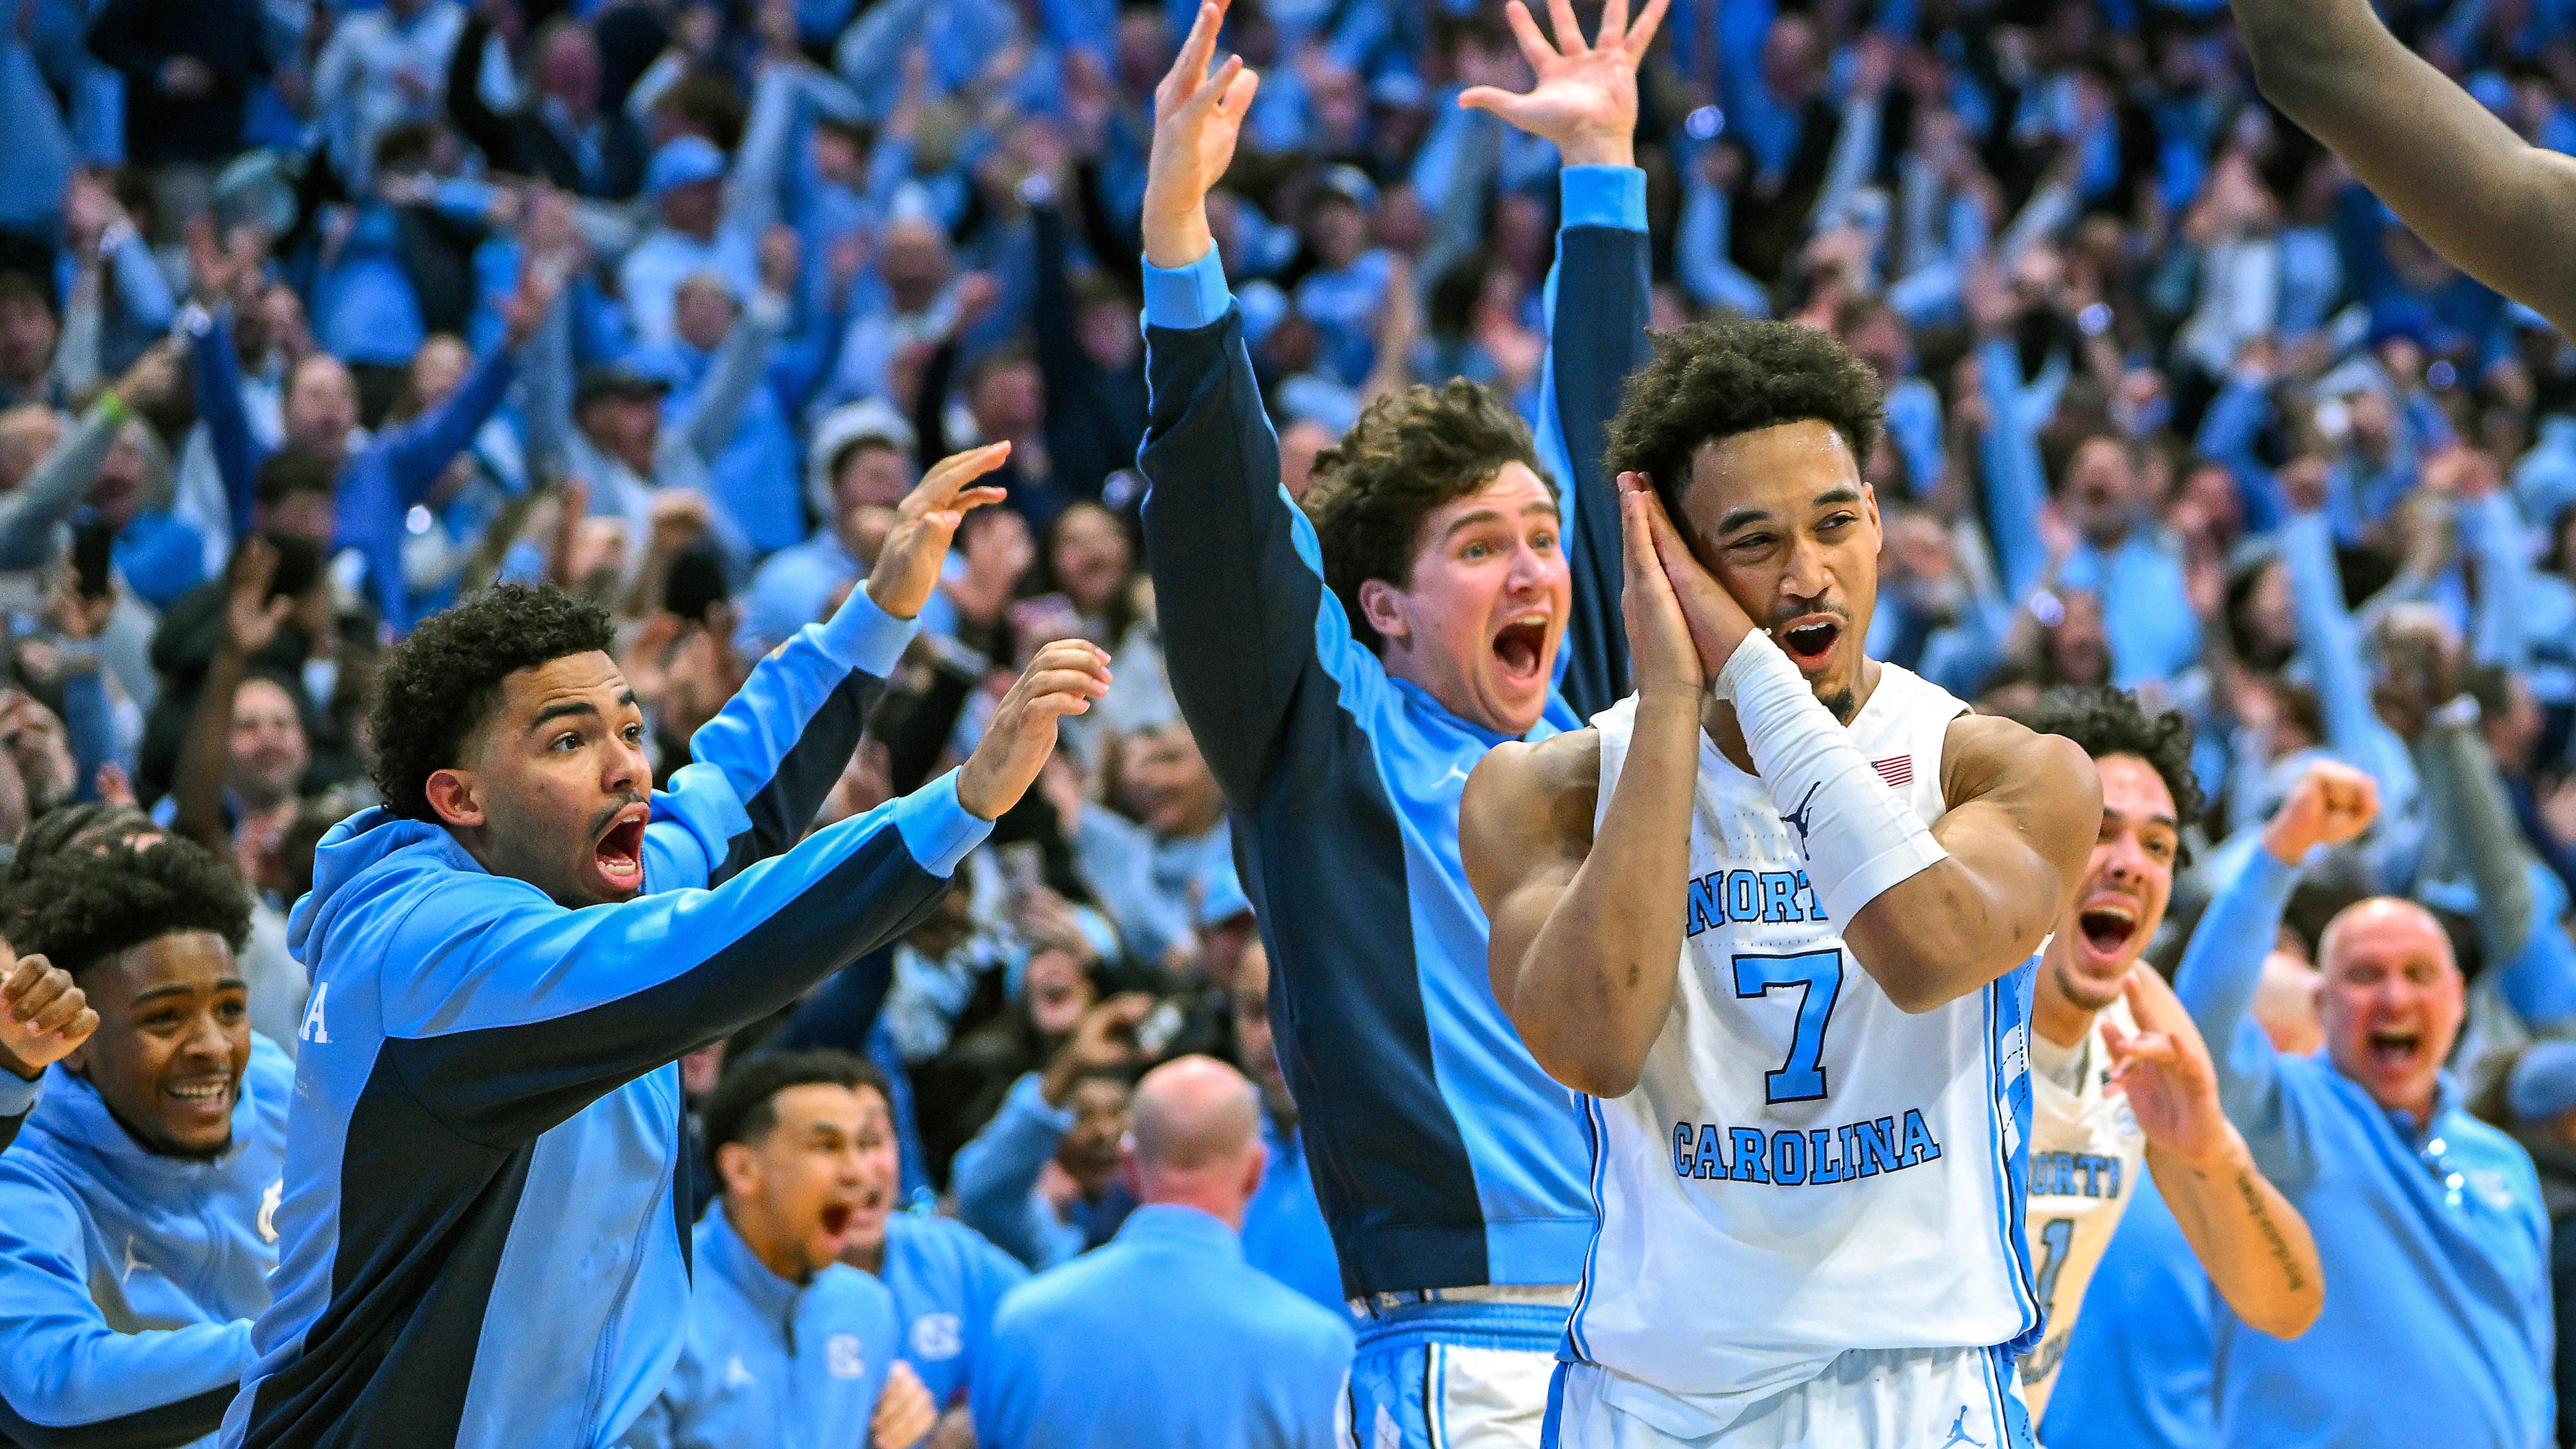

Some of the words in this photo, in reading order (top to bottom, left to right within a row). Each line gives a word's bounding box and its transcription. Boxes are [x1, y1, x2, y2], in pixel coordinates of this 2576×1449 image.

[1687, 869, 1829, 937] NOR
[1732, 948, 1842, 1105] 7
[1673, 1109, 1941, 1186] CAROLINA
[2030, 1150, 2123, 1198] ORTH
[2037, 1218, 2075, 1322] 1
